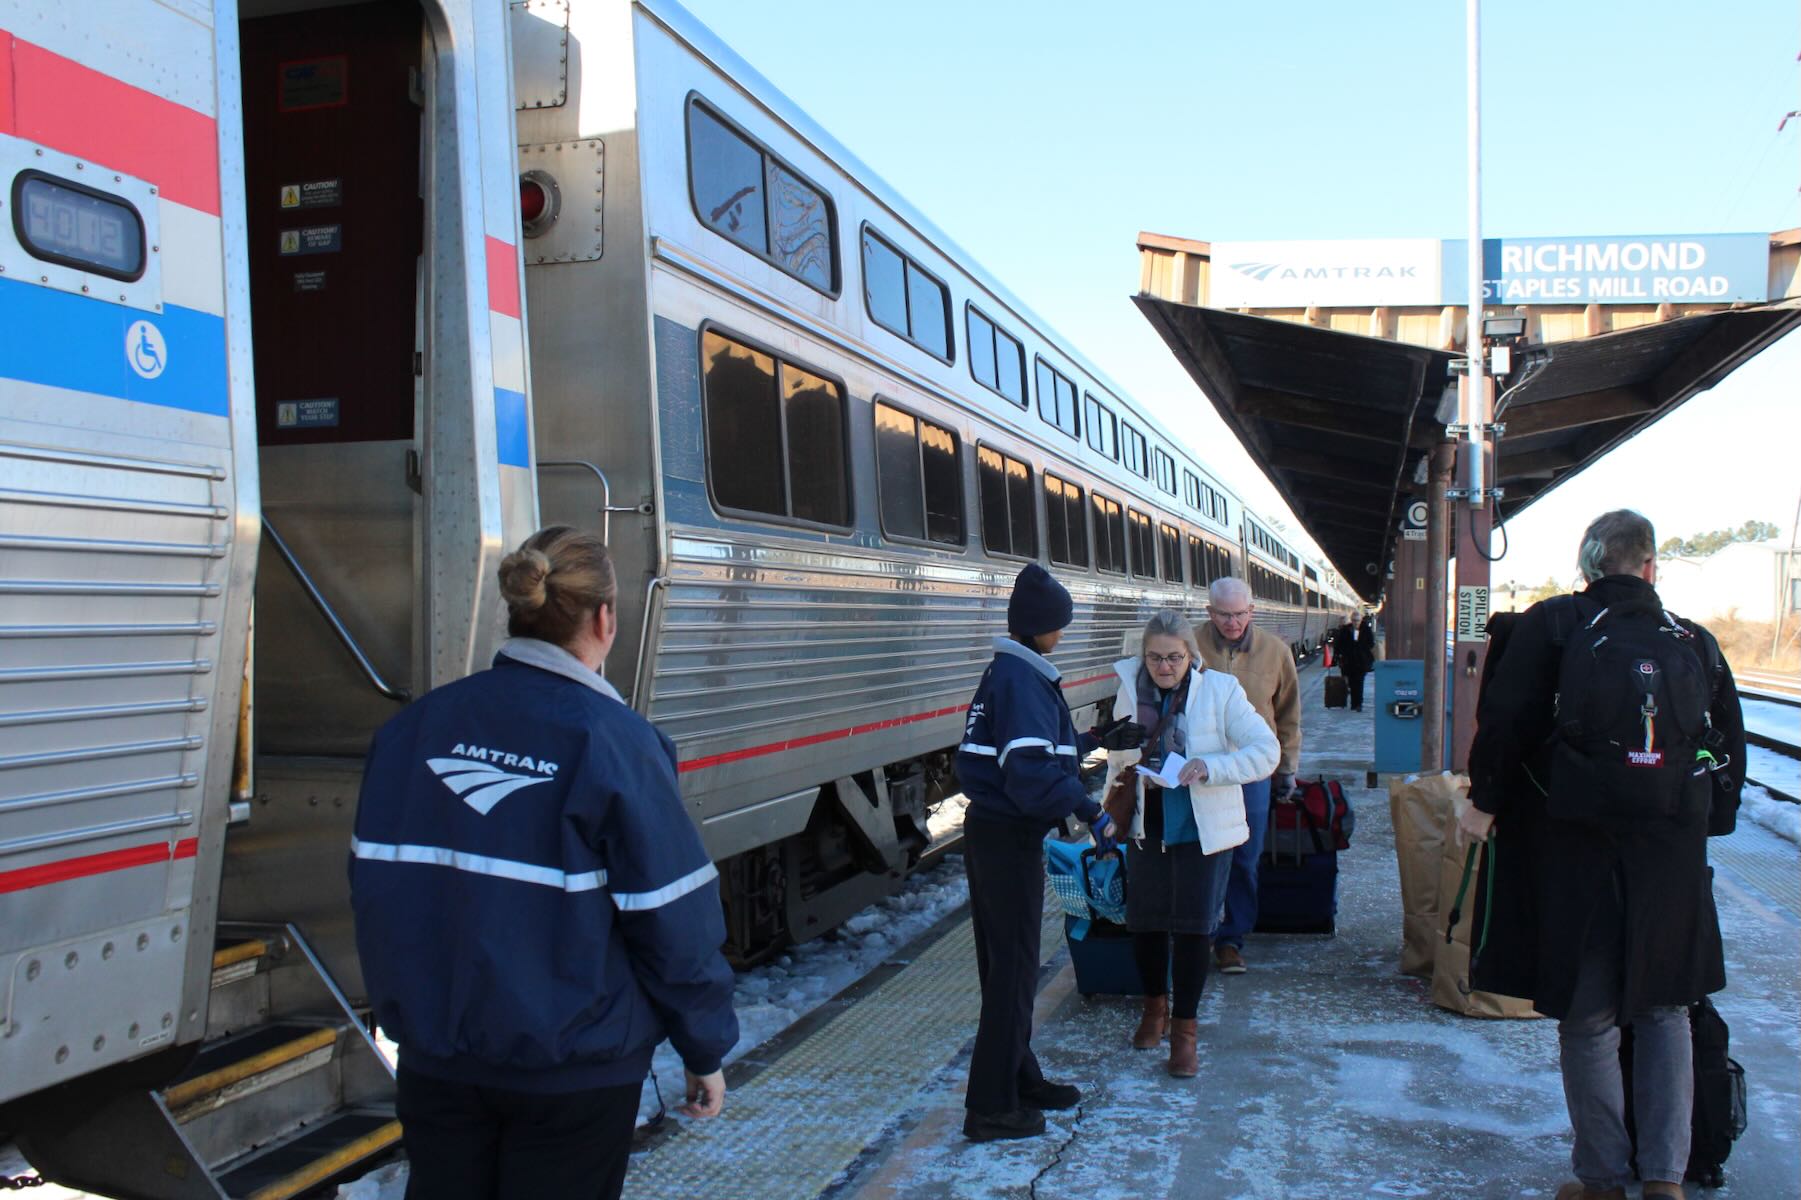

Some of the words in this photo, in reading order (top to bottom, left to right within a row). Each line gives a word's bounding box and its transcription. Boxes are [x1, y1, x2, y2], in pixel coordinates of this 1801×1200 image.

[303, 181, 338, 191] CAUTION!
[30, 201, 119, 253] 4012
[1502, 242, 1706, 272] RICHMOND
[1280, 266, 1418, 280] AMTRAK
[1482, 278, 1581, 299] STAPLES
[1589, 277, 1648, 298] MILL
[1653, 276, 1730, 298] ROAD
[299, 401, 336, 410] CAUTION!
[1459, 591, 1471, 635] STATION
[1474, 588, 1488, 640] SPILL-KIT
[451, 743, 559, 775] AMTRAK
[1628, 751, 1662, 760] MAXIMUM
